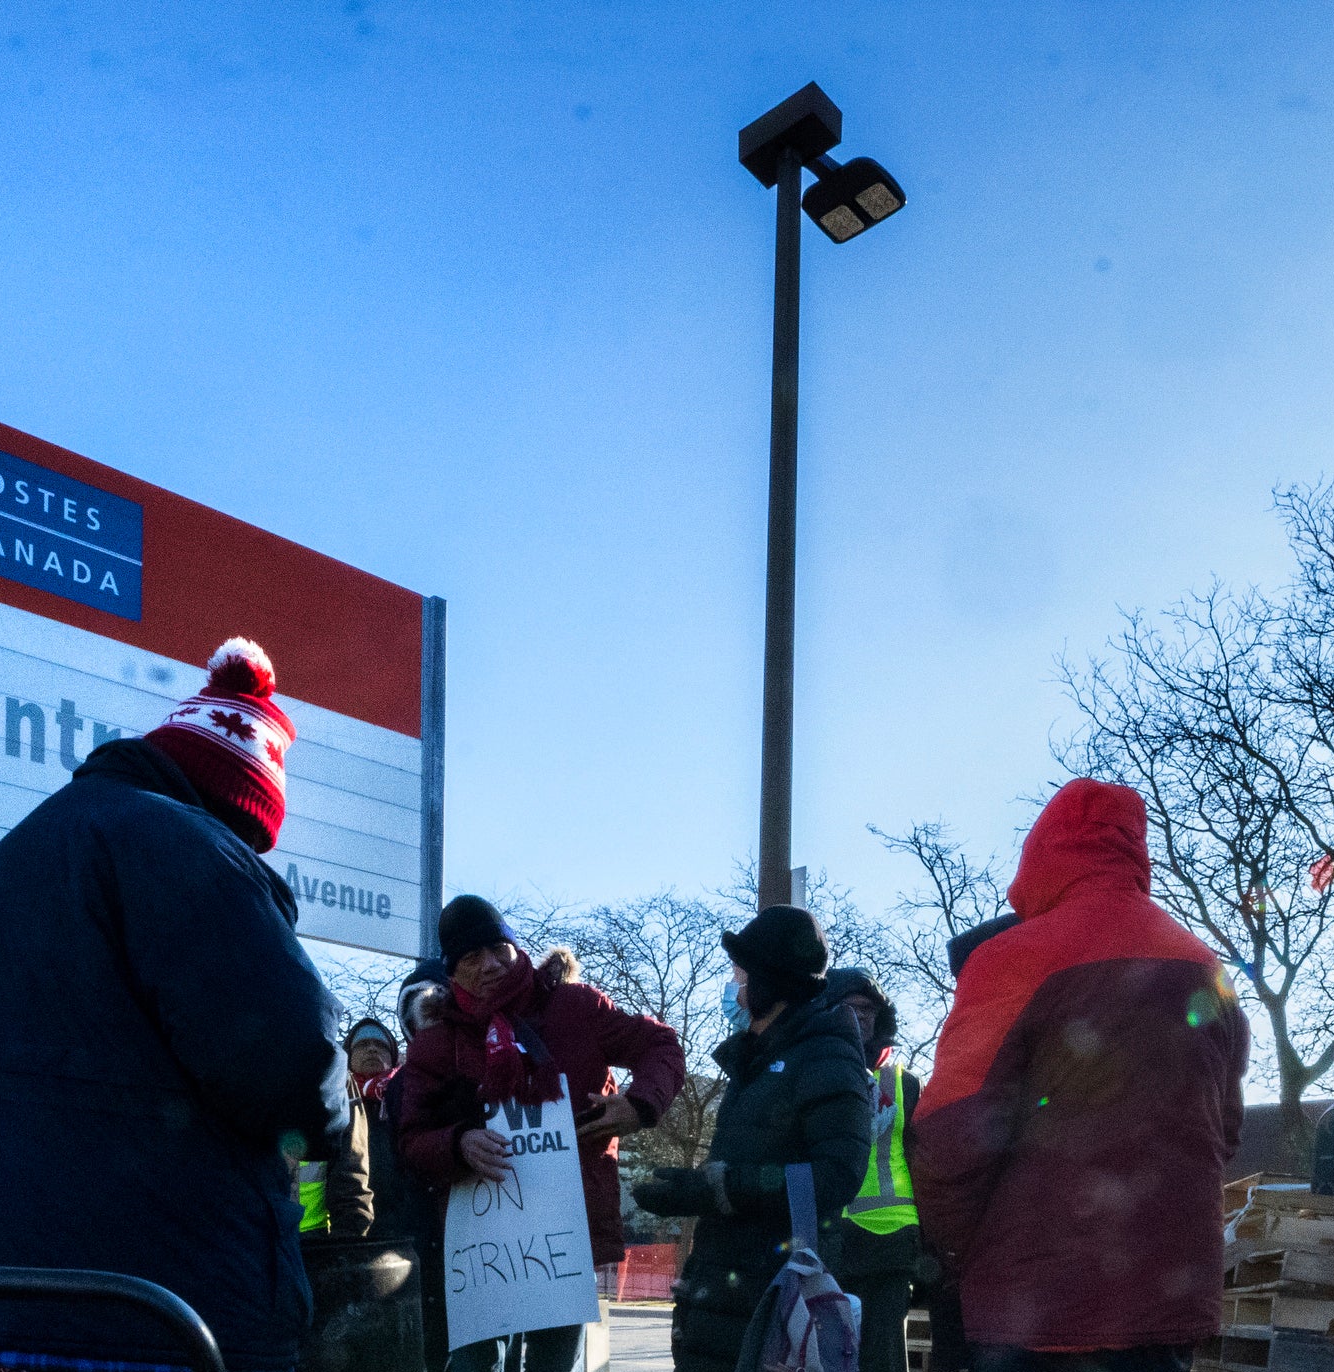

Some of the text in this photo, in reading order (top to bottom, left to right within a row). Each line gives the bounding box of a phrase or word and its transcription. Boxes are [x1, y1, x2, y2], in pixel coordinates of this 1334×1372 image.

[286, 862, 392, 920] Avenue
[503, 1130, 570, 1157] OCAL
[471, 1167, 524, 1217] ON
[451, 1231, 583, 1293] STRIKE
